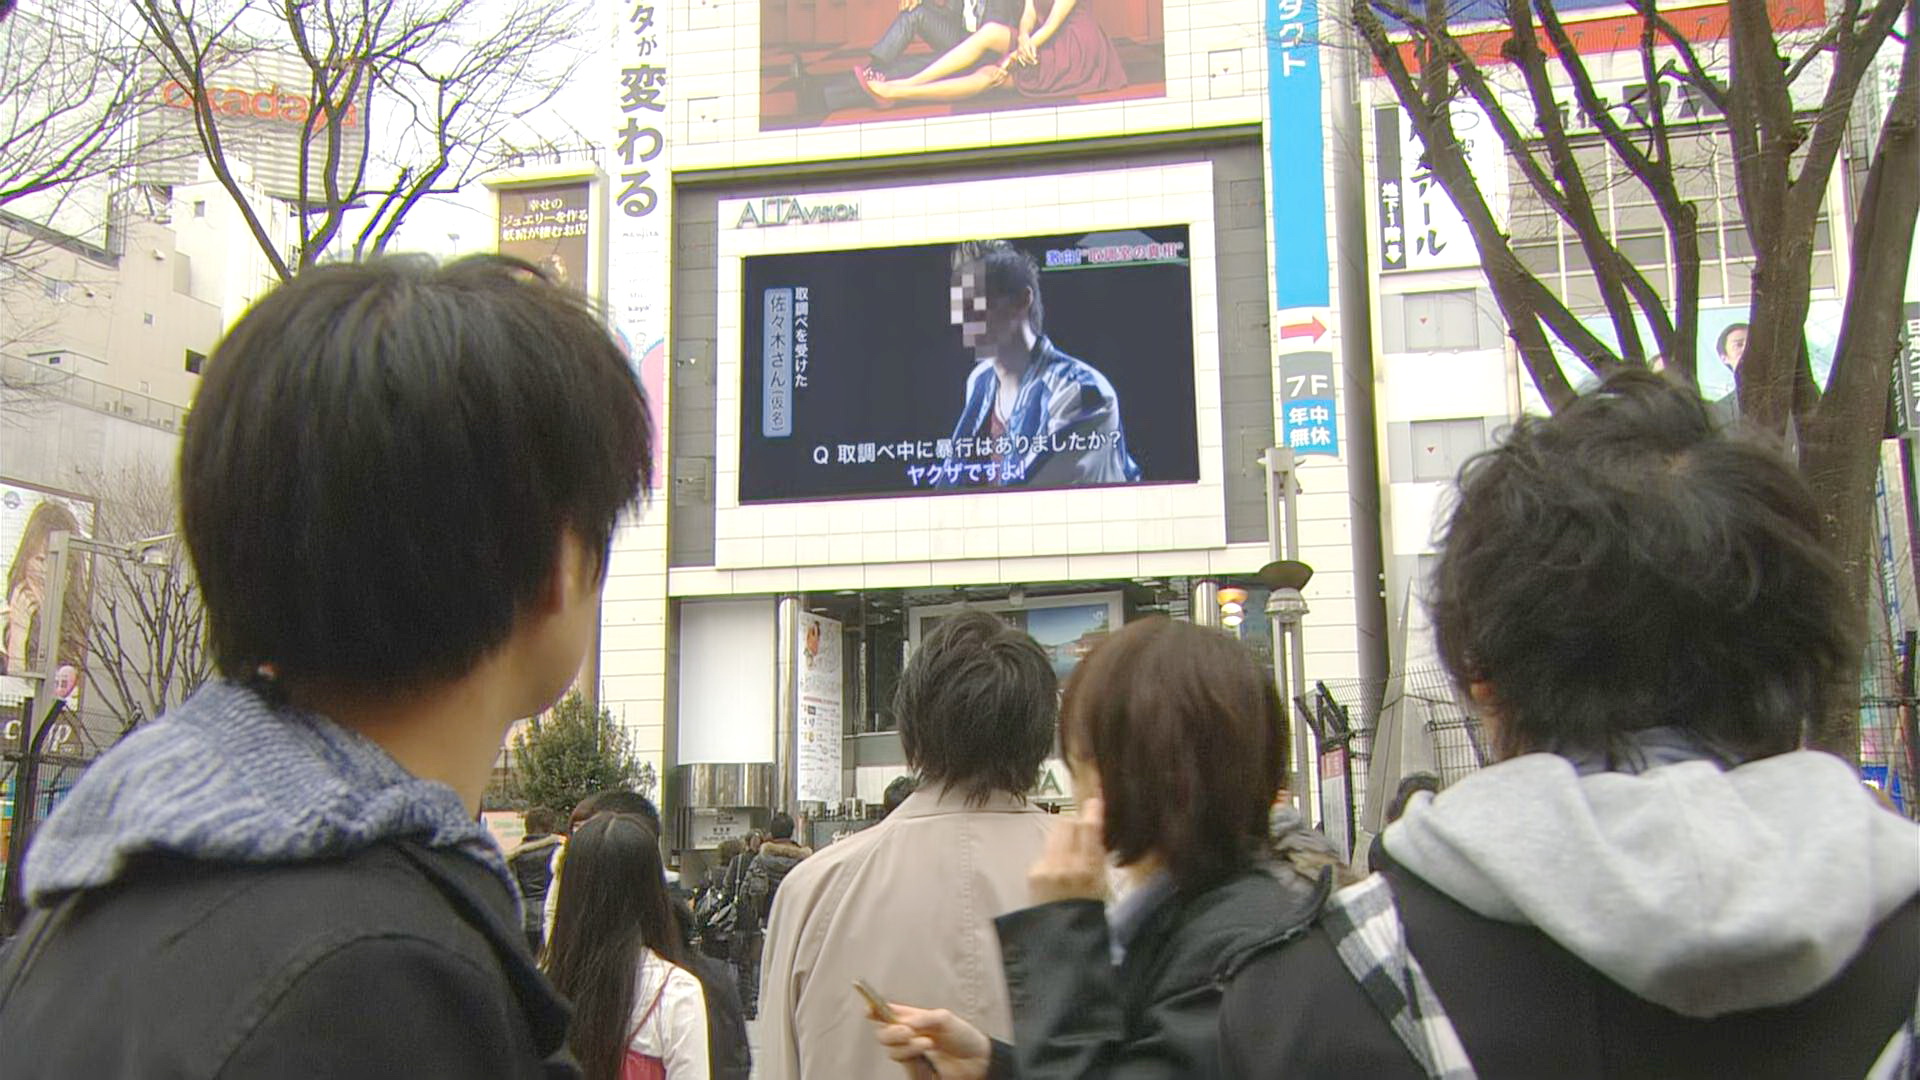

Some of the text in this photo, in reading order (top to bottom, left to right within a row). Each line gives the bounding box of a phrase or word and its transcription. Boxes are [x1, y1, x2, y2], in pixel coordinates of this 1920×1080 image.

[616, 0, 667, 217] タが変わる
[530, 198, 563, 212] 幸せの
[502, 209, 588, 228] ジュエリーを作る
[795, 287, 808, 387] 取調べを受けた
[1286, 374, 1328, 397] 7F
[1289, 405, 1329, 425] 年中
[1290, 427, 1331, 447] 無休
[813, 446, 829, 464] Q
